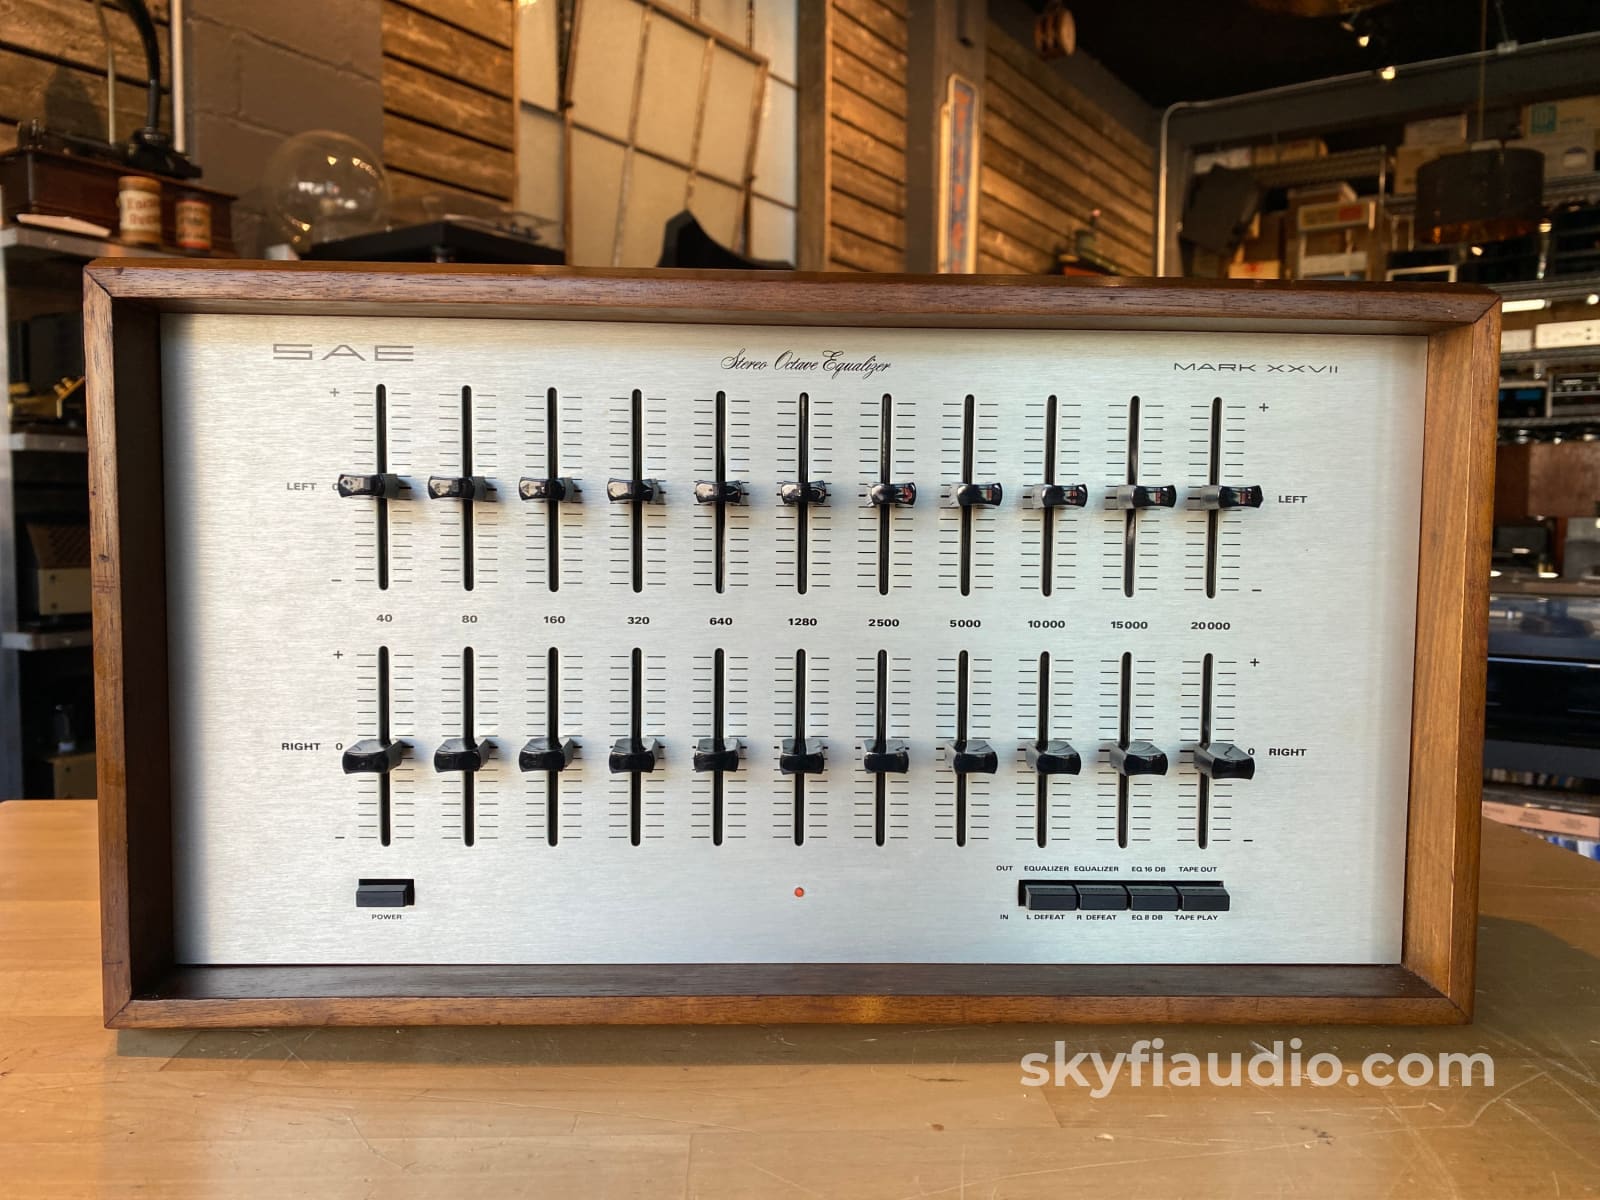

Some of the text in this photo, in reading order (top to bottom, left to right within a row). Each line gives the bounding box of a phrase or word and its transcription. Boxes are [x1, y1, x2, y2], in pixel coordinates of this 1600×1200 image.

[272, 343, 415, 362] SAE
[720, 347, 892, 379] Stereo Octave Equalizer
[1173, 362, 1338, 374] MARK XXVII
[286, 482, 317, 491] LEFT
[1278, 495, 1308, 504] LEFT
[376, 613, 393, 623] 40
[461, 614, 478, 624] 80
[543, 615, 566, 624] 160
[627, 616, 650, 625] 320
[709, 616, 733, 626] 640
[788, 617, 818, 627] 1280
[868, 618, 900, 628] 2500
[949, 619, 982, 628] 5000
[1027, 620, 1066, 629] 10000
[1110, 620, 1149, 630] 15000
[281, 742, 343, 751] RIGHT 0
[1268, 748, 1308, 757] RIGHT
